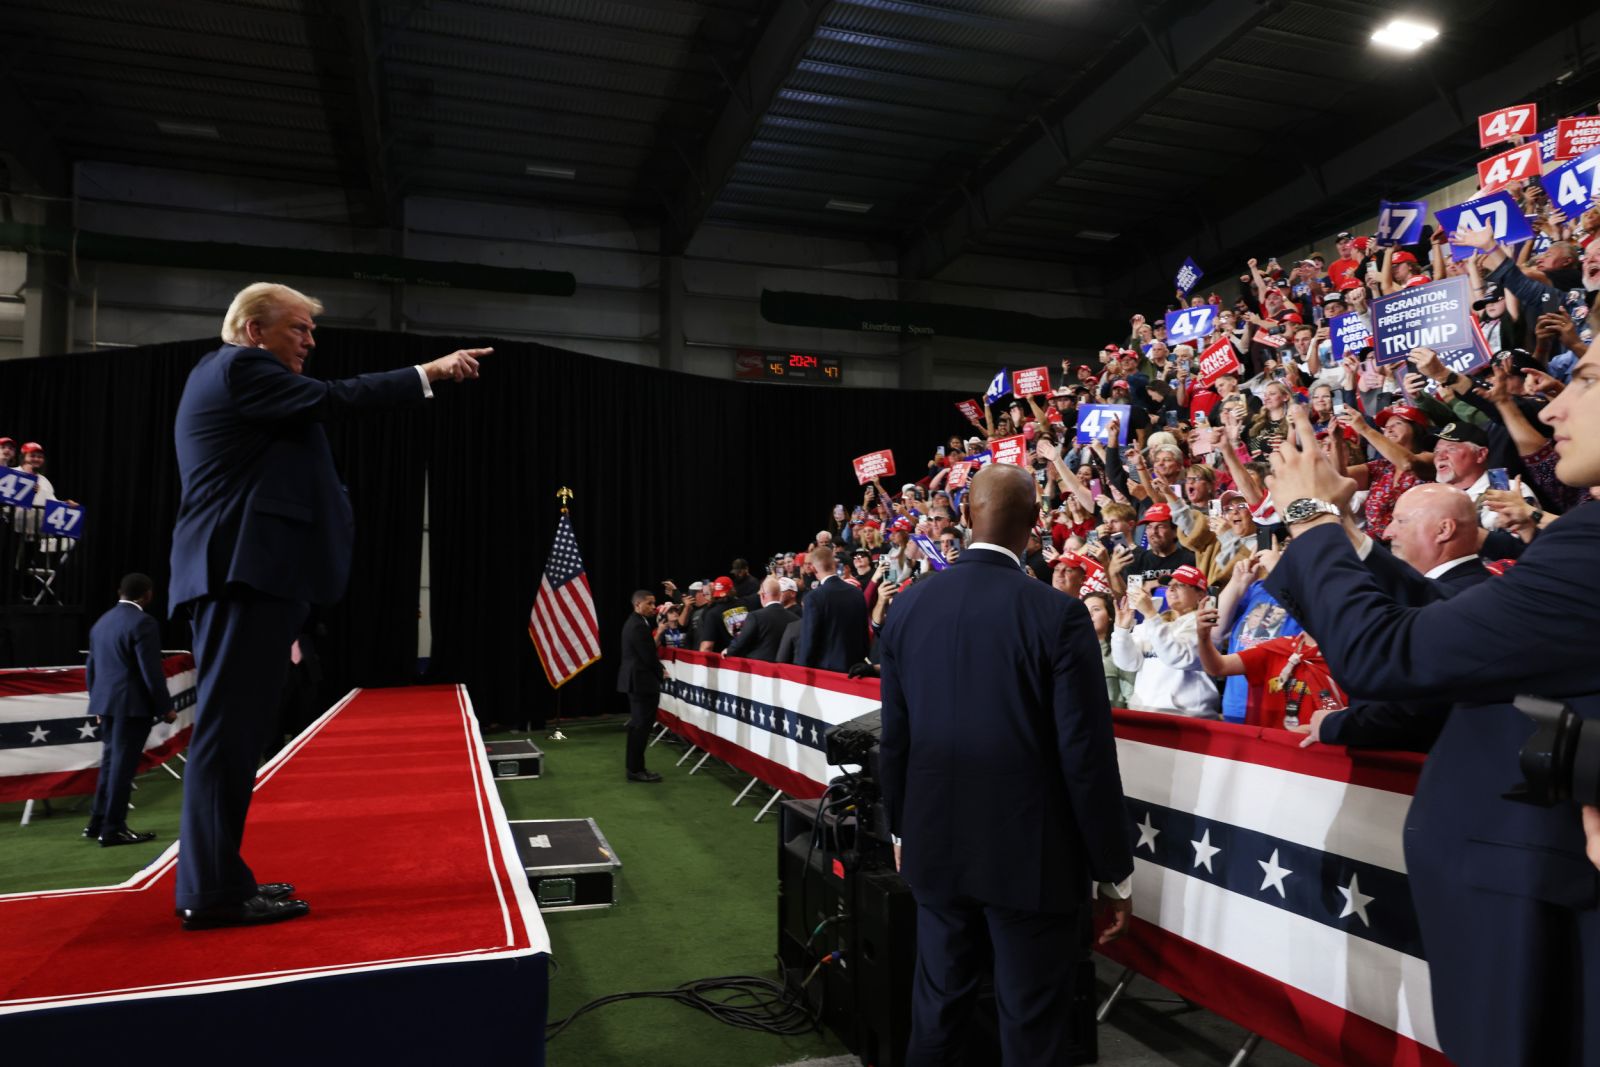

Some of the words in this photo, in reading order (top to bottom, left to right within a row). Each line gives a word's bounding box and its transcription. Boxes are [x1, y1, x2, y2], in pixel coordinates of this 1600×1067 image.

[1485, 108, 1530, 137] 47
[1564, 127, 1600, 138] AMER
[1576, 120, 1600, 128] MAK
[1484, 147, 1533, 185] 47
[1557, 154, 1600, 207] 47
[1378, 208, 1419, 240] 47
[1456, 200, 1508, 240] 47
[1378, 299, 1459, 328] FIREFIGHTERS
[1385, 289, 1447, 314] SCRANTON
[1171, 308, 1211, 336] 47
[1336, 323, 1363, 337] AMER
[1405, 319, 1422, 329] FOR
[1342, 330, 1369, 343] GREA
[1382, 323, 1458, 355] TRUMP
[770, 363, 784, 375] 45
[1200, 345, 1230, 370] TRUMP
[824, 367, 839, 378] 47
[987, 372, 1004, 396] 47
[1080, 409, 1123, 438] 47
[999, 439, 1018, 450] MAKE
[0, 473, 35, 501] 47
[47, 506, 81, 531] 47
